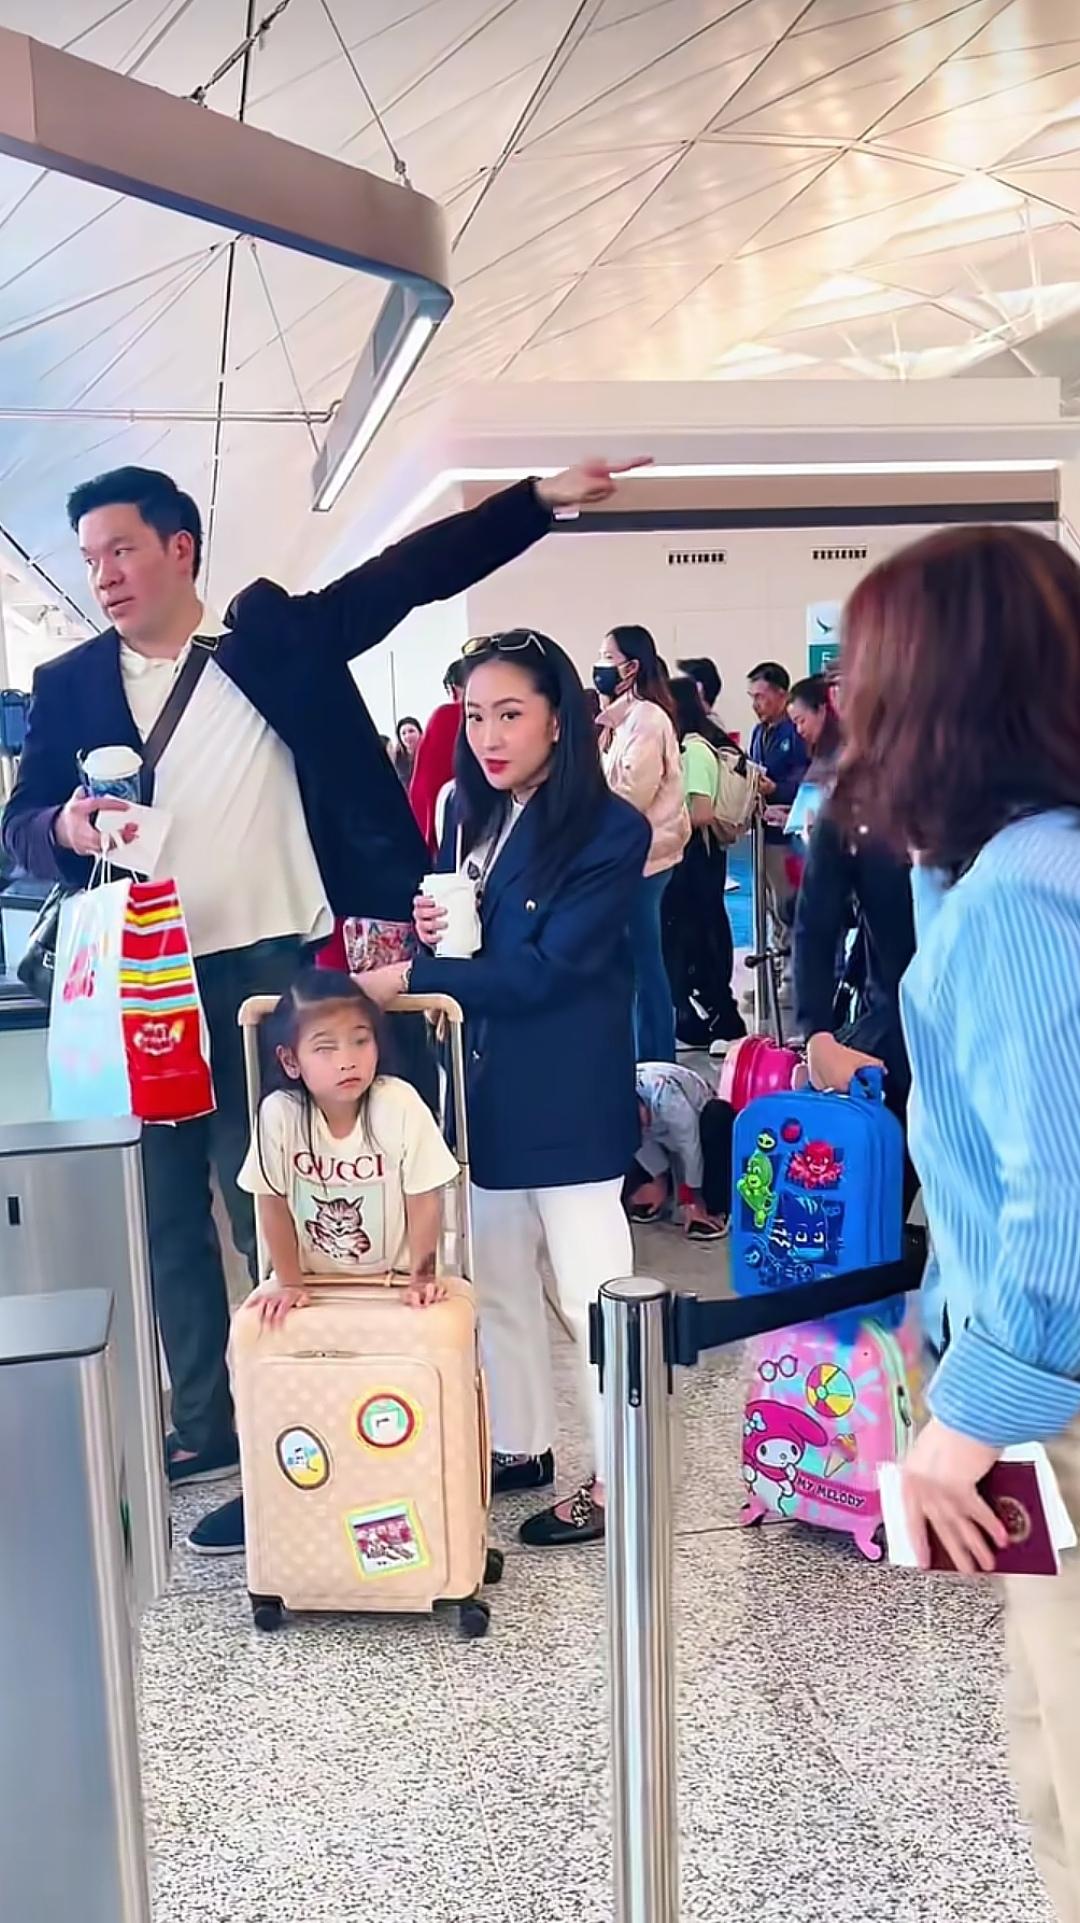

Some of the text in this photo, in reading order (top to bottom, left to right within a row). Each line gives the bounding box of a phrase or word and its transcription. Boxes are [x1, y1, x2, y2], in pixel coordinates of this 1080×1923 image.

[294, 1152, 383, 1182] GUCCI
[797, 1477, 865, 1507] MY MELODY
